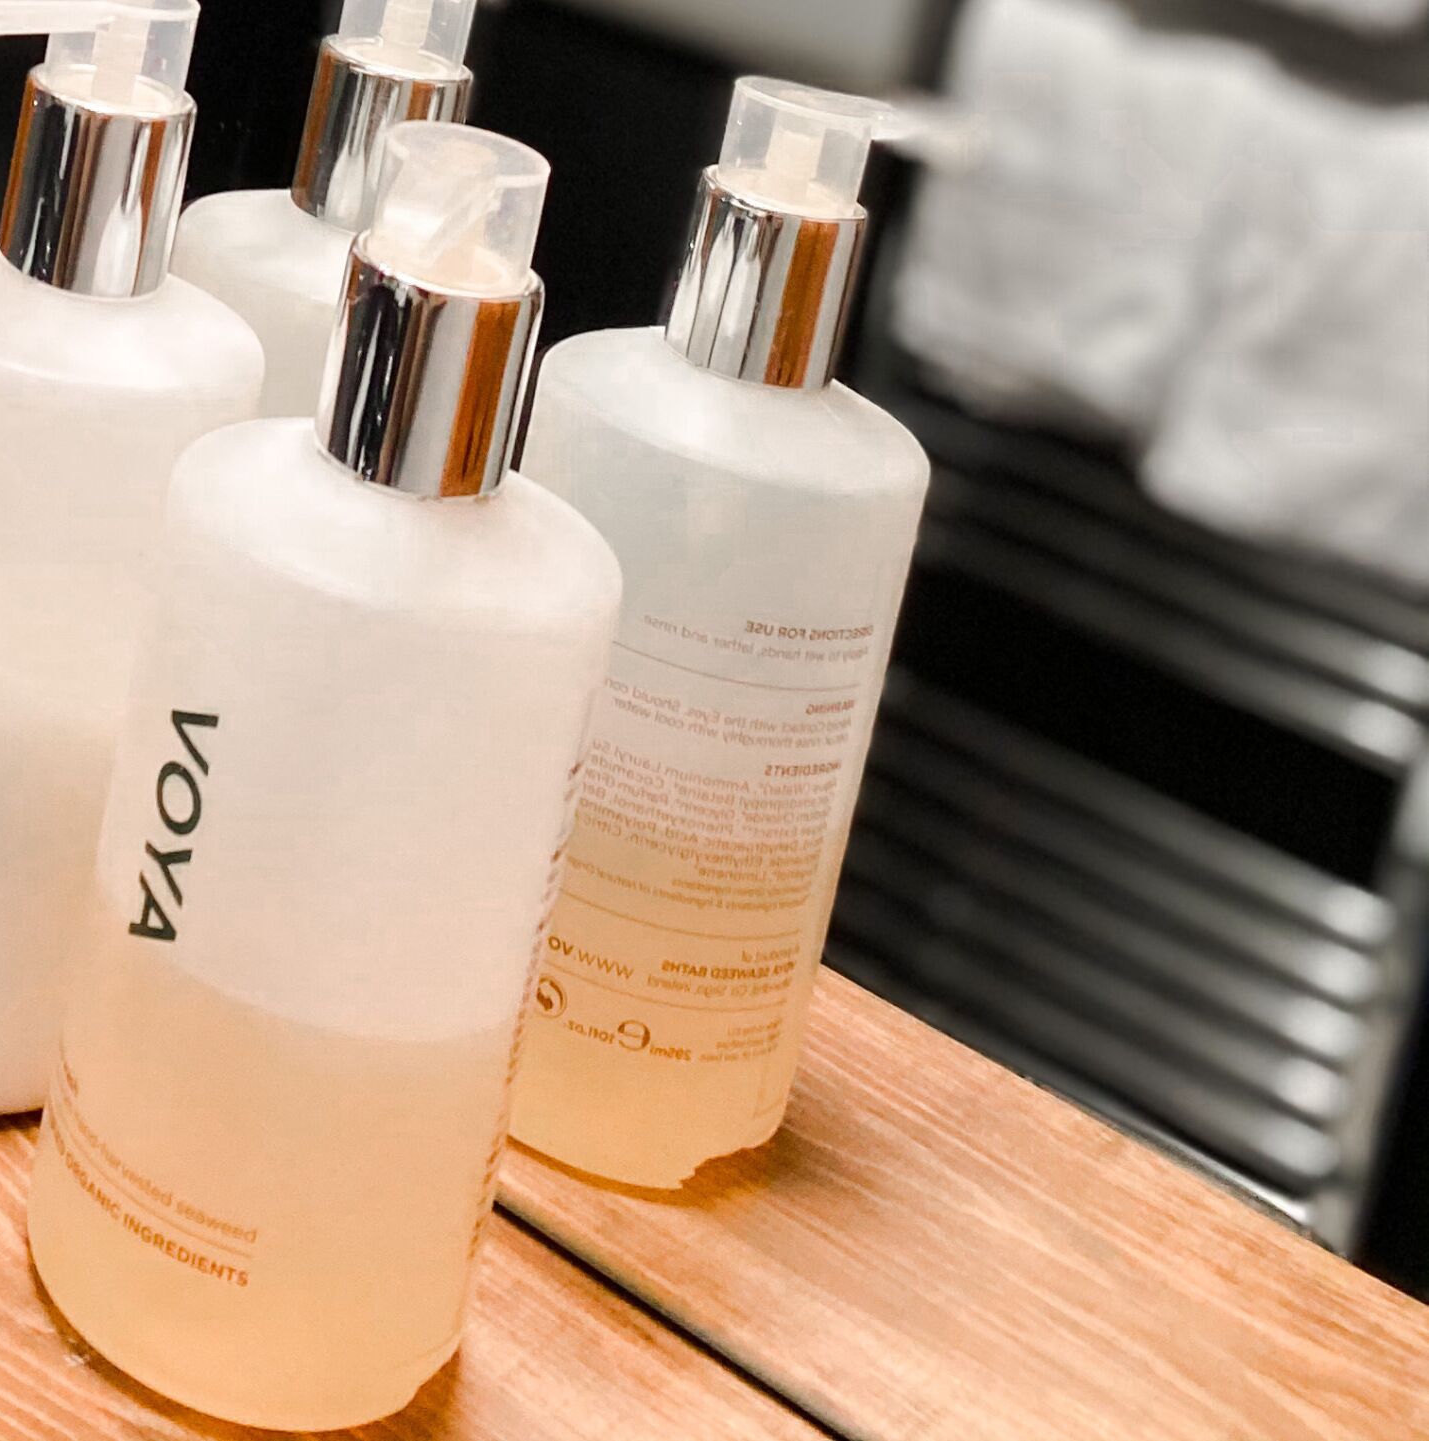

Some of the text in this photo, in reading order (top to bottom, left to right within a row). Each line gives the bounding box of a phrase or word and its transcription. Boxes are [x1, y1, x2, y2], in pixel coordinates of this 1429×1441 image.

[128, 709, 220, 943] VOYA
[65, 1150, 249, 1288] ORGANIC INGREDIENTS
[176, 1200, 258, 1245] seaweed
